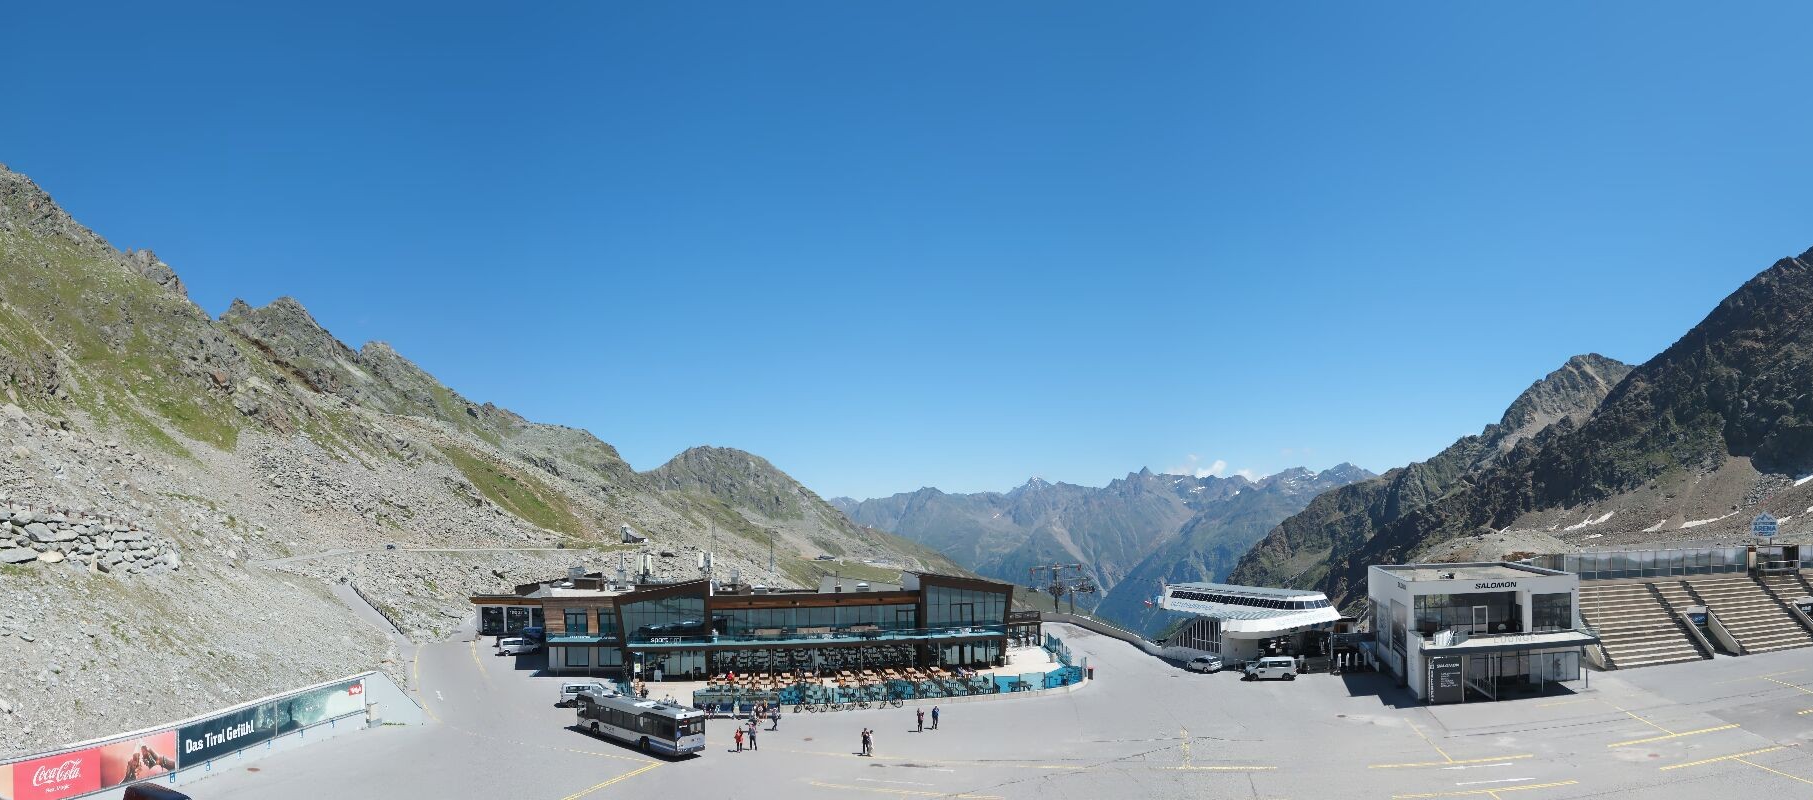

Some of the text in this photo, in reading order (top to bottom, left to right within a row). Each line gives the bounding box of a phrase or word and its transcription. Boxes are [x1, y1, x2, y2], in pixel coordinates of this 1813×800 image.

[1474, 581, 1517, 590] SALOMON
[1493, 635, 1535, 644] LOUNGE
[185, 719, 255, 754] Das Tirol Gefühl
[32, 758, 83, 787] Coca-Cola
